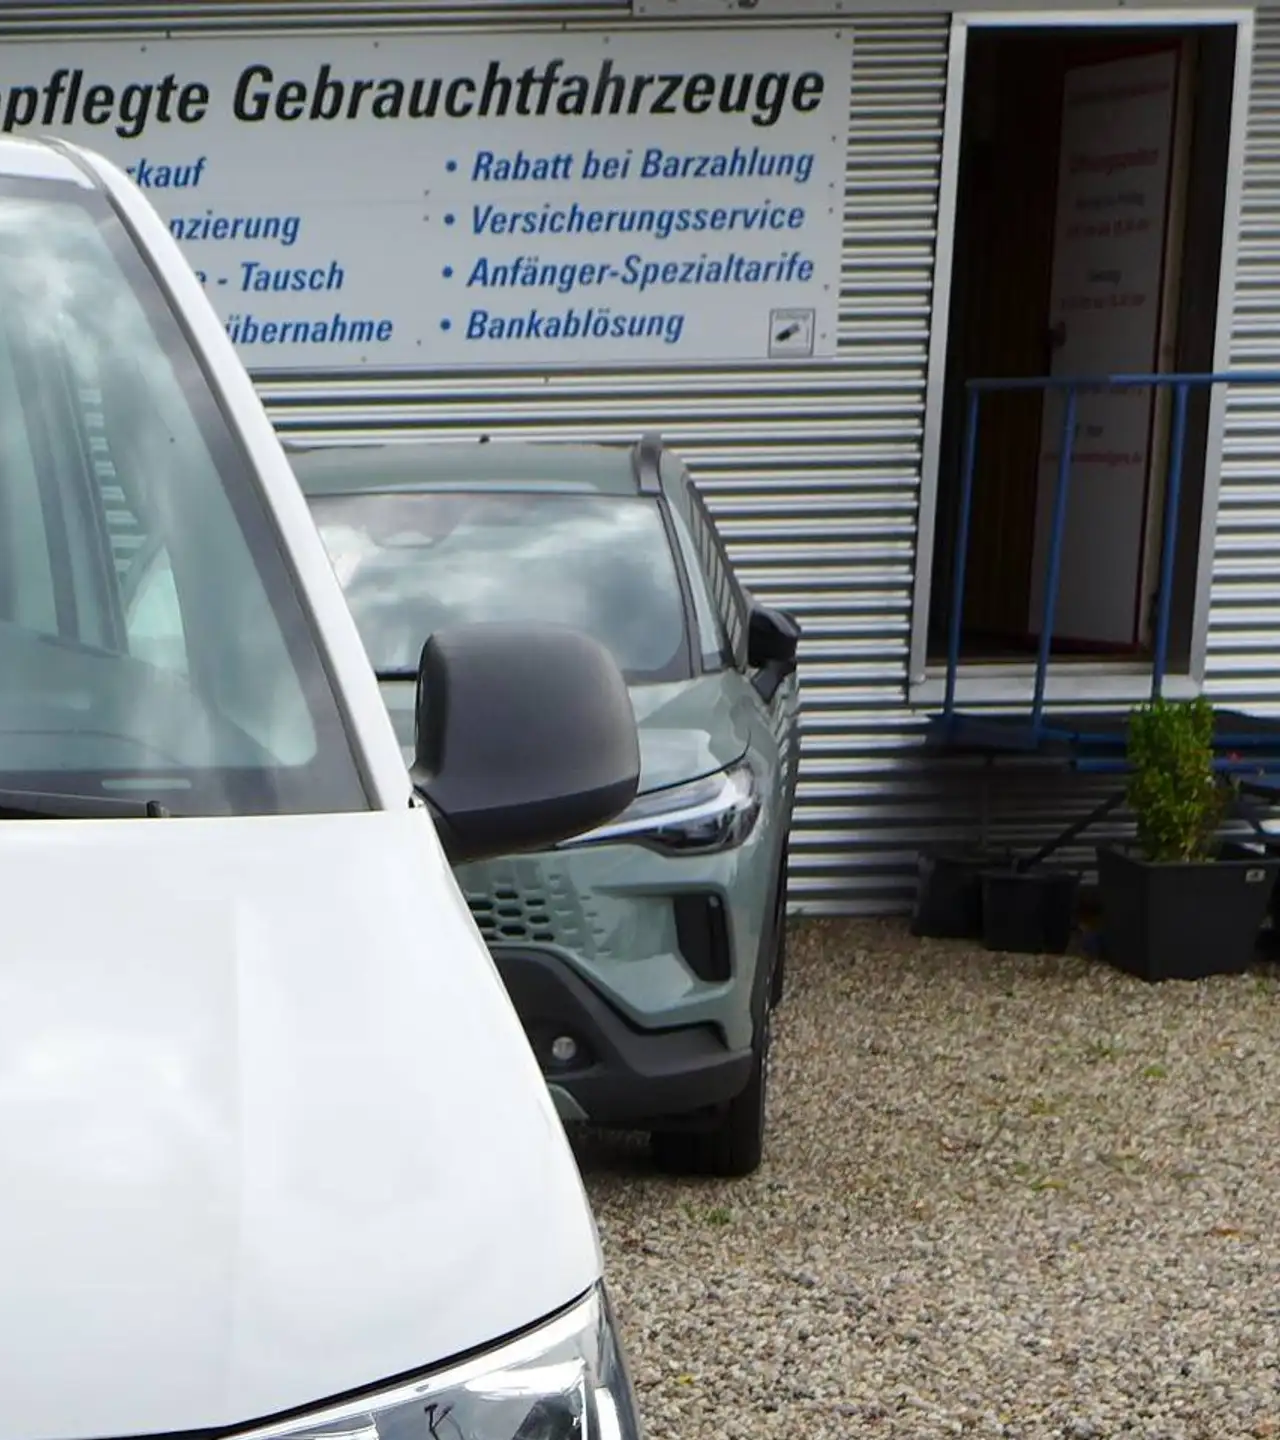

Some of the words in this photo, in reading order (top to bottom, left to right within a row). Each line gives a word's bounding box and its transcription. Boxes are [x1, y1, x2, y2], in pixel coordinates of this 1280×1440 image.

[233, 58, 825, 127] Gebrauchtfahrzeuge
[471, 150, 573, 182] Rabatt
[582, 149, 633, 180] bei
[640, 147, 815, 184] Barzahlung
[169, 209, 300, 246] nzierung
[472, 200, 805, 240] Versicherungsservice
[239, 260, 344, 292] Tausch
[466, 251, 815, 294] Anfänger-Spezialtarife
[465, 307, 685, 344] Bankablösung
